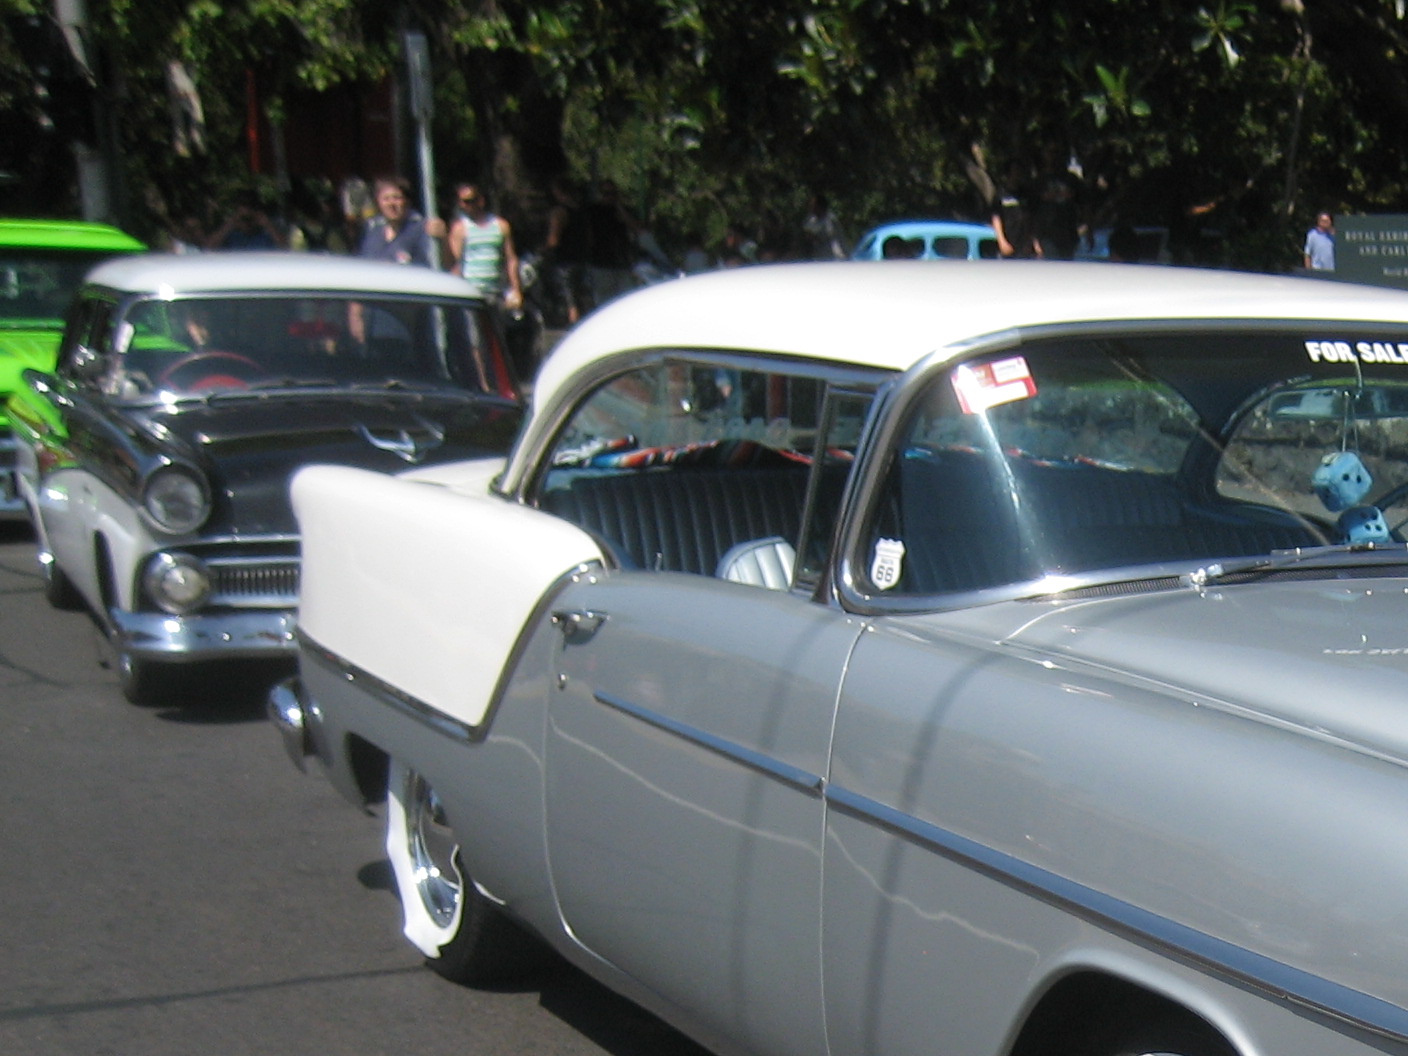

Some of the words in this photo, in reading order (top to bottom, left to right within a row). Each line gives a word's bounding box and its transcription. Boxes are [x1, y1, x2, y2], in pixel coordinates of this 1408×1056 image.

[1345, 231, 1375, 242] ROYAL
[1359, 245, 1378, 256] AND
[1304, 341, 1357, 363] FOR
